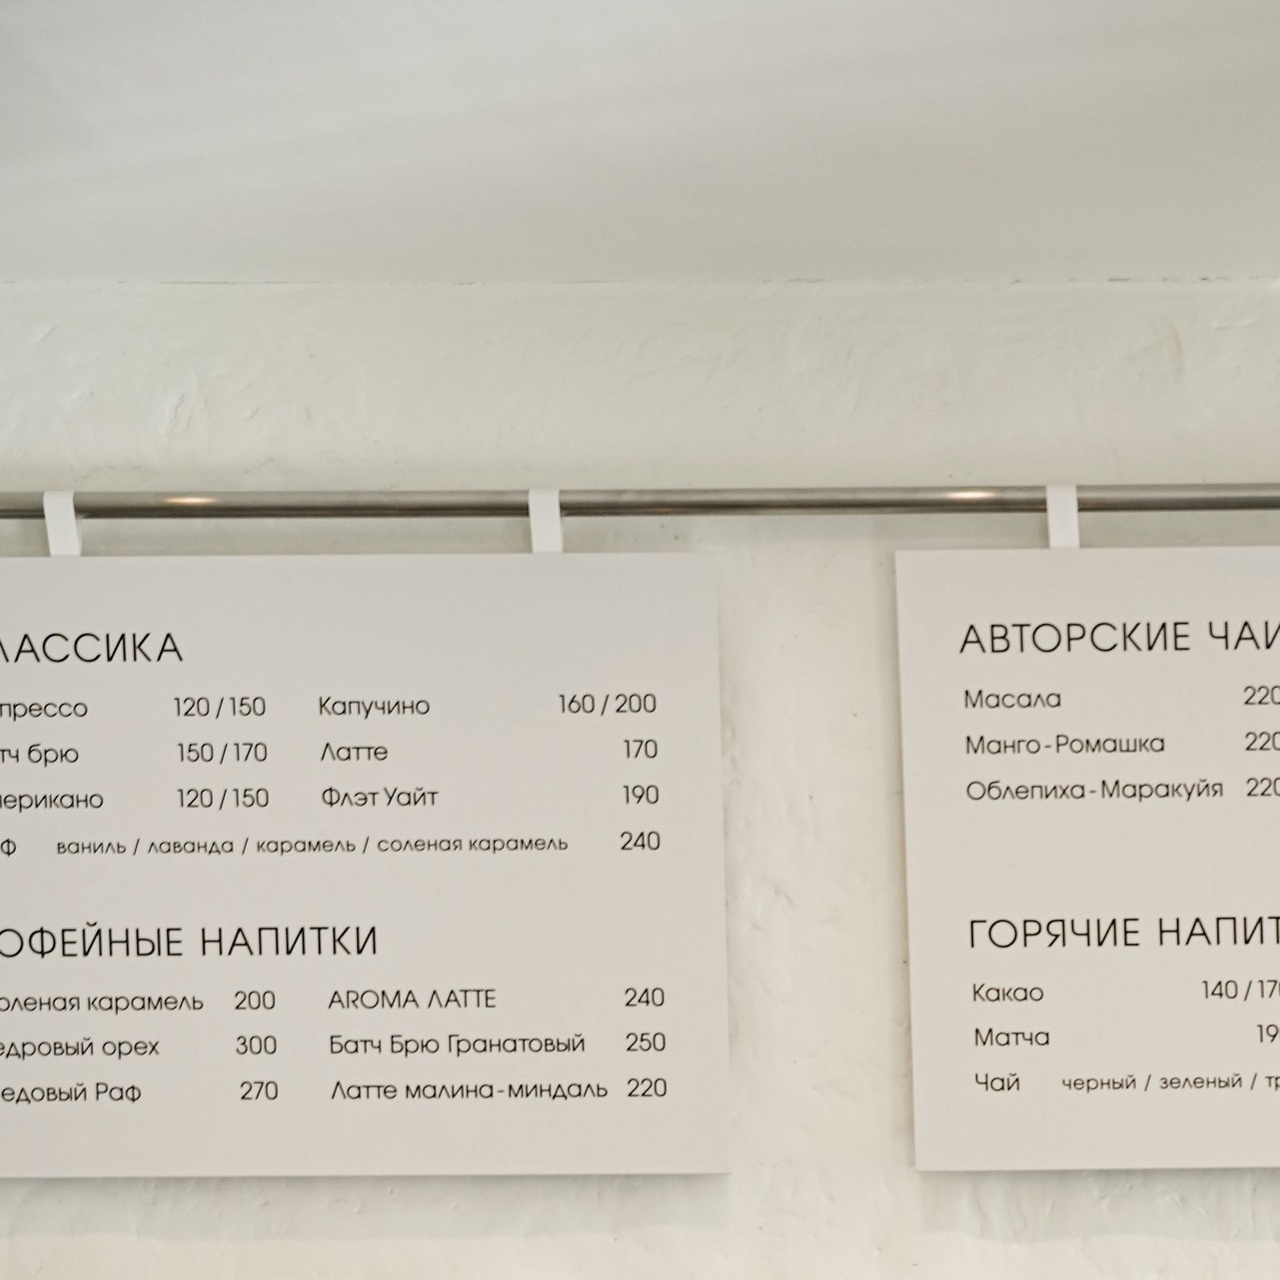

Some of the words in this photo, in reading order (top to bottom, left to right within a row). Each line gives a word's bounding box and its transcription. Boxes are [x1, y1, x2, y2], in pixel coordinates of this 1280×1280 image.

[958, 621, 1191, 655] АВТОРСКИЕ
[318, 695, 431, 721] Капучино
[963, 688, 1062, 710] Масала
[0, 702, 89, 723] прессо
[27, 743, 80, 769] брю
[320, 741, 389, 762] Латте
[623, 738, 659, 760] 170
[965, 733, 1166, 756] Манго-Ромашка
[0, 792, 104, 814] ерикано
[321, 786, 380, 809] Флэт
[382, 786, 440, 808] Уайт
[622, 784, 660, 805] 190
[965, 778, 1224, 803] Облепиха-Маракуйя
[56, 841, 127, 855] ваниль
[147, 840, 234, 856] лаванда
[256, 839, 357, 857] карамель
[376, 838, 463, 853] соленая
[468, 837, 569, 855] карамель
[619, 830, 661, 852] 240
[0, 921, 184, 960] ОФЕЙНЫЕ
[200, 925, 377, 957] НАПИТКИ
[969, 917, 1141, 949] ГОРЯЧИЕ
[0, 995, 81, 1013] оленая
[86, 994, 205, 1016] карамель
[234, 989, 276, 1011] 200
[624, 986, 666, 1008] 240
[972, 982, 1045, 1003] Какао
[101, 1040, 160, 1061] орех
[235, 1034, 278, 1056] 300
[329, 1034, 382, 1055] Батч
[389, 1033, 441, 1059] Брю
[447, 1032, 586, 1058] Гранатовый
[625, 1031, 667, 1053] 250
[974, 1026, 1051, 1047] Матча
[0, 1082, 88, 1106] едовый
[95, 1081, 142, 1104] Раф
[239, 1080, 279, 1101] 270
[330, 1080, 398, 1101] Латте
[626, 1077, 668, 1098] 220
[974, 1072, 1021, 1093] Чай
[1061, 1074, 1137, 1094] черный
[1159, 1072, 1243, 1090] зеленый
